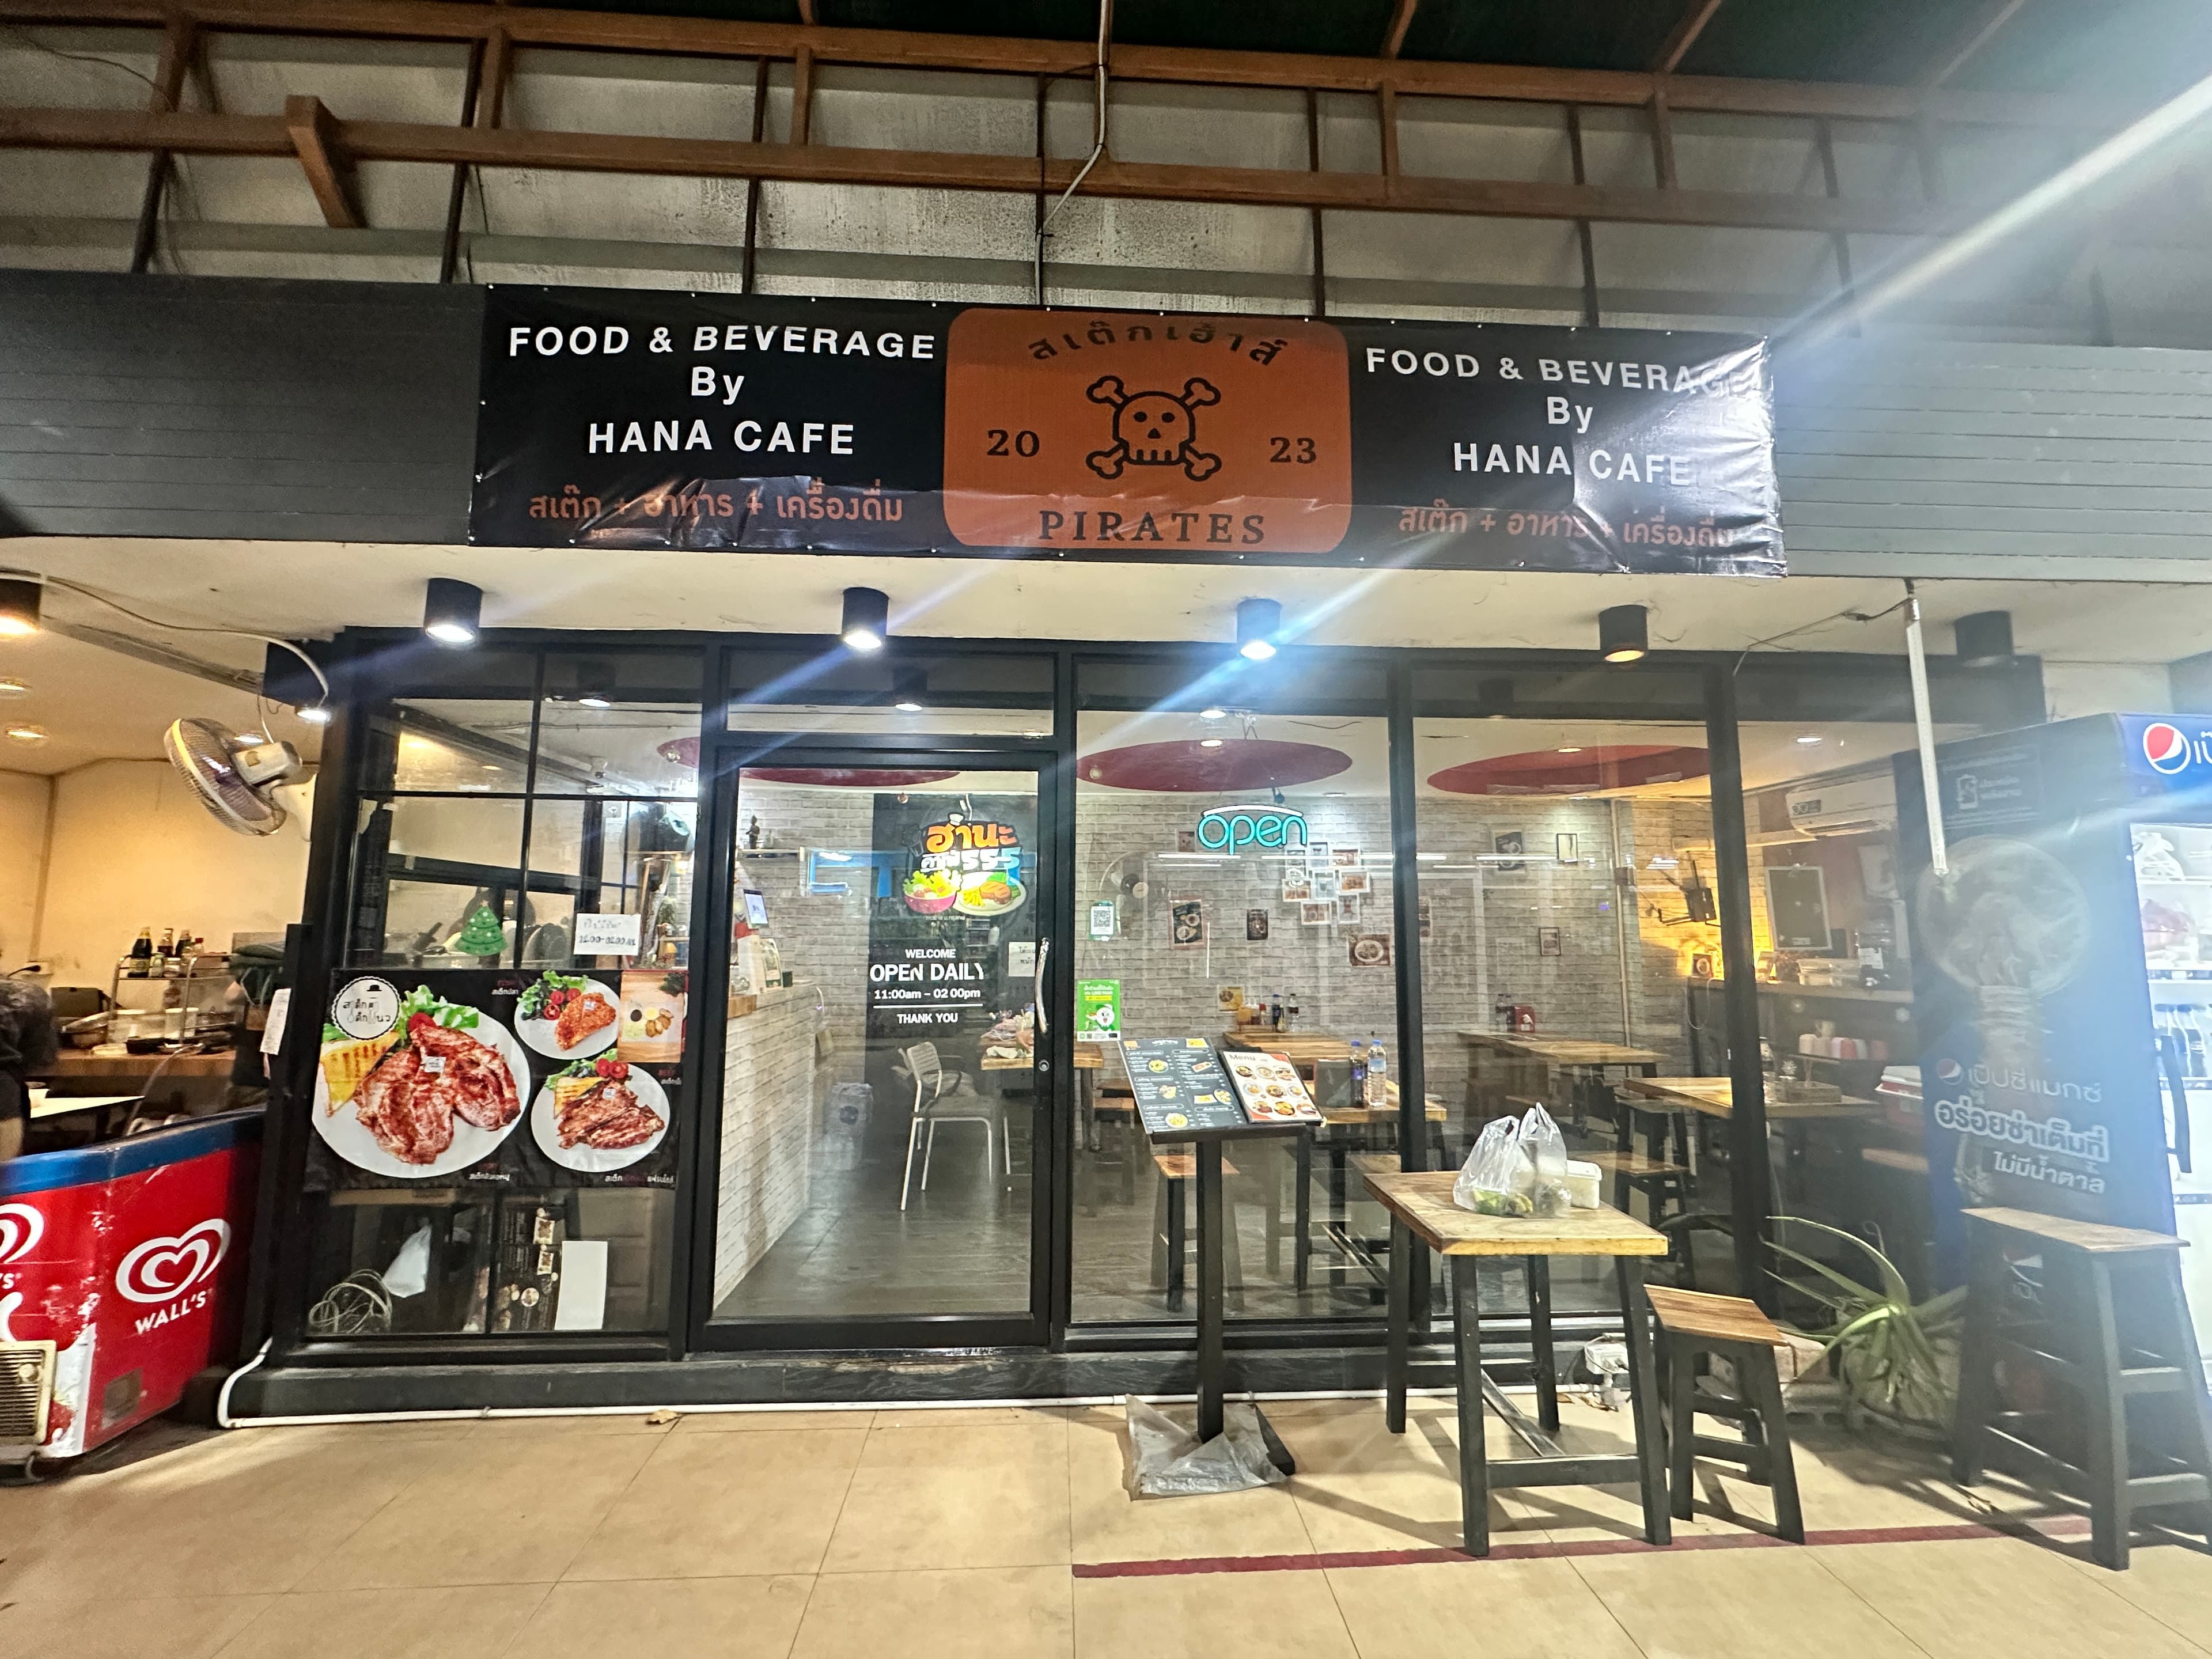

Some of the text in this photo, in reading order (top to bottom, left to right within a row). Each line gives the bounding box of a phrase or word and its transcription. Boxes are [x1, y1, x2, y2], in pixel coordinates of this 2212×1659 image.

[510, 325, 935, 359] FOOD & BEVERAGE
[1366, 347, 1480, 378] FOOD
[1499, 357, 1524, 380] &
[691, 366, 745, 406] By
[1547, 396, 1593, 434] By
[588, 419, 854, 455] HANA CAFE
[987, 429, 1040, 457] 20
[1270, 437, 1317, 464] 23
[1453, 442, 1691, 486] HANA CAFE
[643, 493, 734, 517] อาหาร
[747, 490, 763, 515] +
[777, 477, 903, 521] เครื่องดื่ม
[1039, 510, 1264, 544] PIRATES
[1480, 514, 1496, 532] +
[1508, 513, 1587, 538] อาหาร
[1198, 814, 1308, 855] open
[905, 949, 956, 959] WELCOME
[870, 963, 984, 982] OPEN DAILY
[874, 989, 922, 999] 11:00am
[897, 1013, 958, 1024] THANK YOU
[1994, 1151, 2105, 1194] ไม่มีน้ำตาล
[135, 1290, 206, 1335] WALL'S
